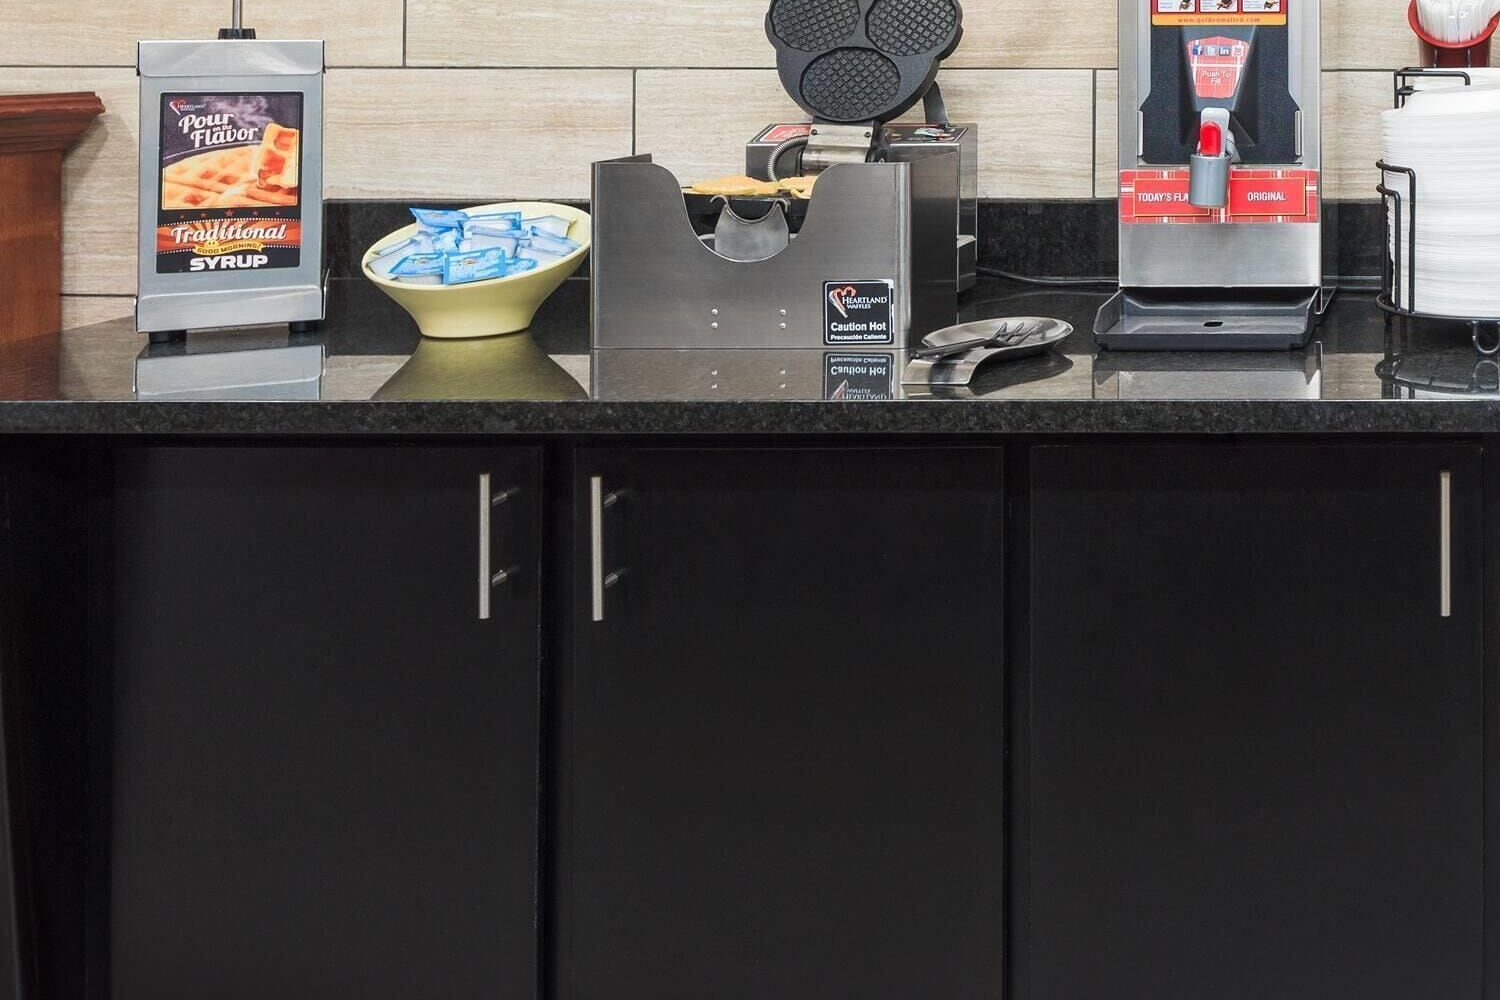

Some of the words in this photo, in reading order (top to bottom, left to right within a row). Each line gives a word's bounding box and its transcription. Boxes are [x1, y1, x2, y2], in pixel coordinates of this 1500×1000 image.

[178, 112, 234, 134] Pour
[191, 126, 258, 148] Flavor
[1137, 192, 1172, 202] TODAY'S
[1174, 192, 1190, 202] FLA
[1247, 192, 1286, 201] ORIGINAL
[170, 223, 287, 244] Traditional
[220, 243, 262, 253] MORNING!
[190, 254, 268, 271] SYRUP
[842, 296, 888, 304] HEARTLAND
[831, 322, 867, 331] Caution
[869, 322, 886, 331] Hot
